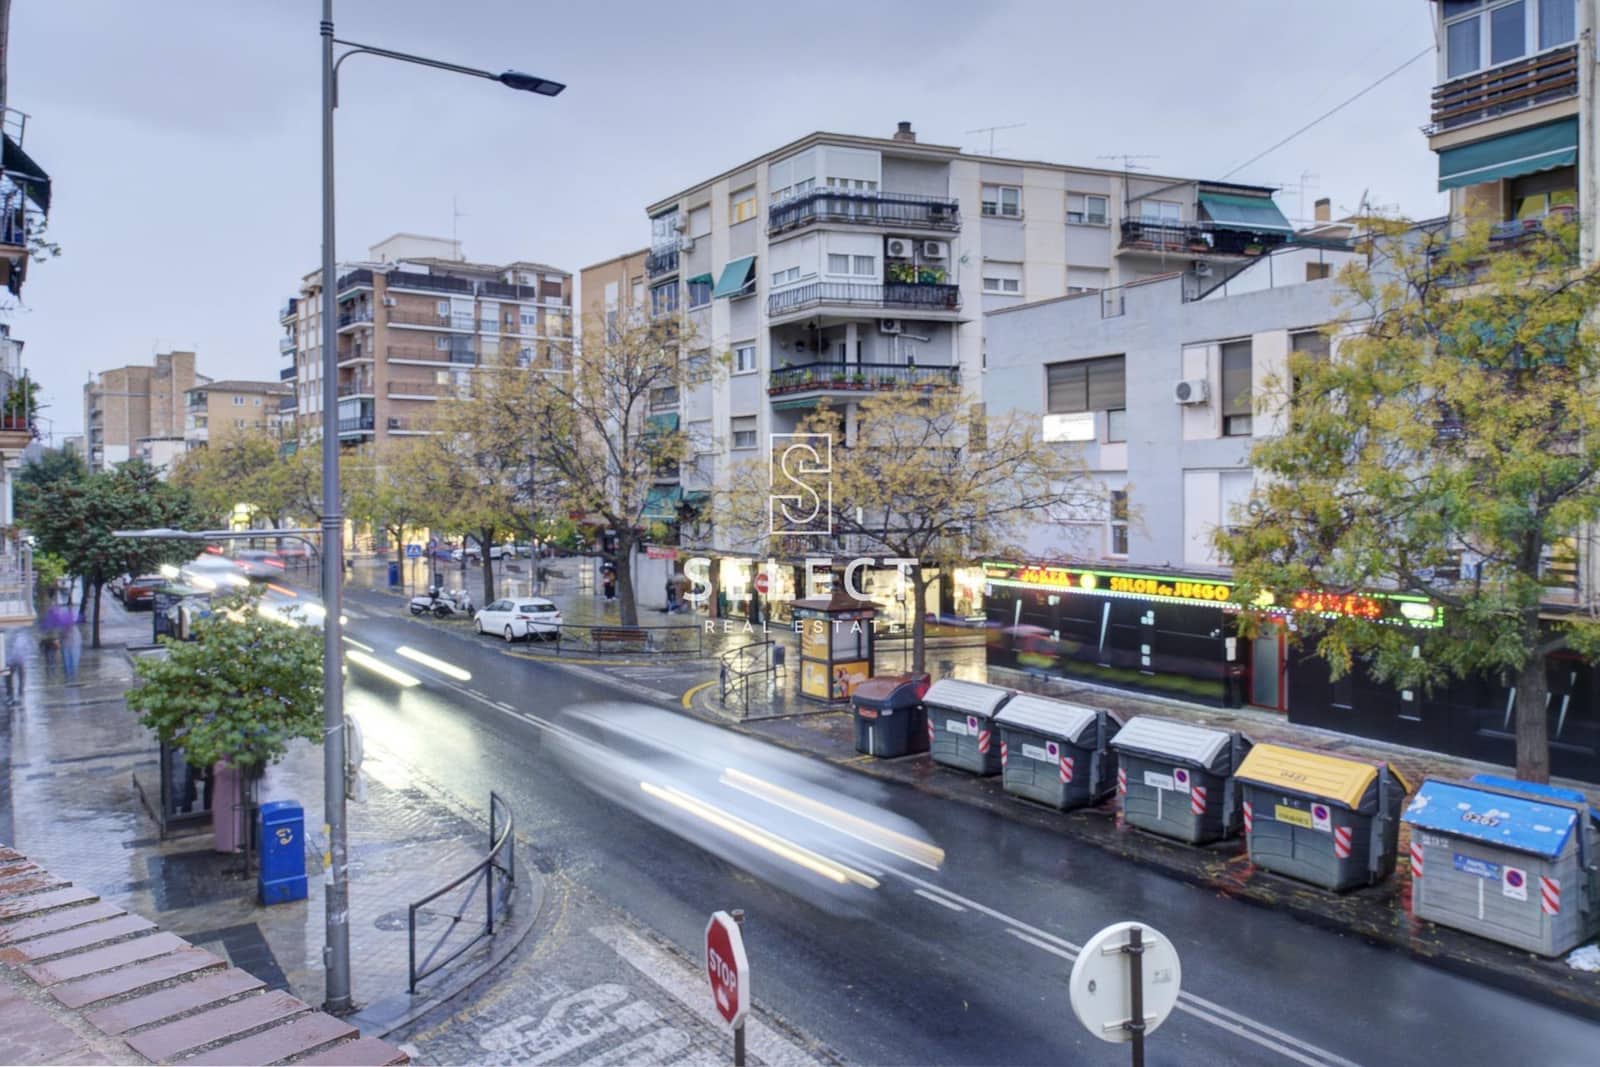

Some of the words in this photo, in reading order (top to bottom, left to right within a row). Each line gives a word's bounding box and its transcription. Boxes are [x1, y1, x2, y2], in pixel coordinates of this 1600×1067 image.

[1109, 576, 1158, 595] SALON
[1174, 580, 1230, 601] JUEGO
[709, 947, 737, 993] STOP
